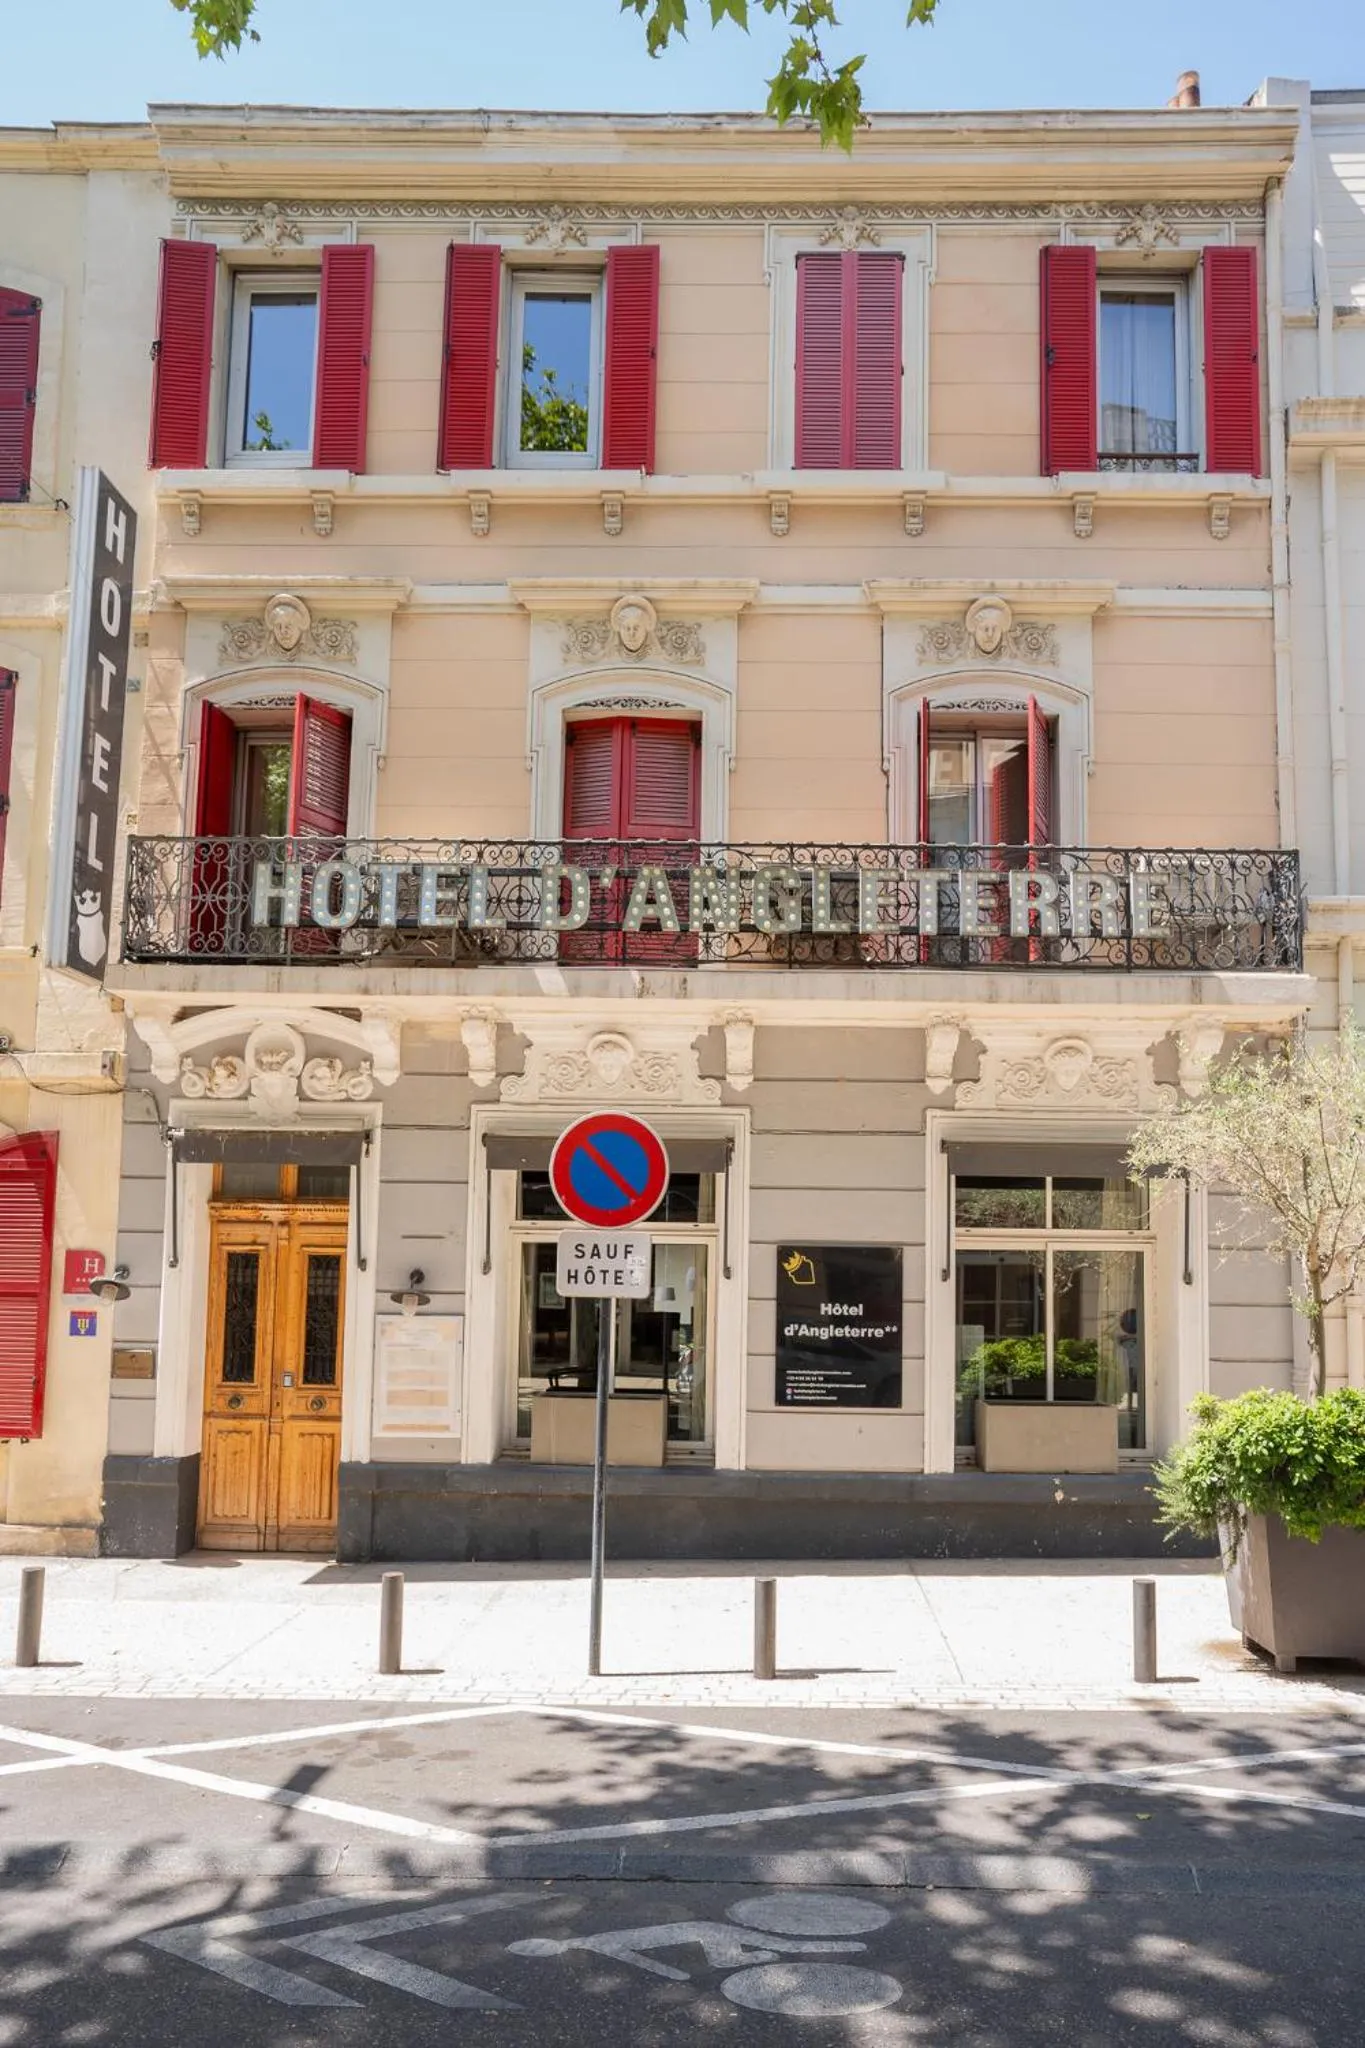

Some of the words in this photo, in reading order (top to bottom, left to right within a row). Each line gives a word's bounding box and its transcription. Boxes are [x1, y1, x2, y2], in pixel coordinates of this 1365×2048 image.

[86, 497, 127, 873] HOTEL
[540, 862, 1172, 938] D'ANGLETERRE
[574, 1243, 634, 1260] SAUF
[83, 1257, 100, 1274] H
[820, 1302, 864, 1317] Hôtel
